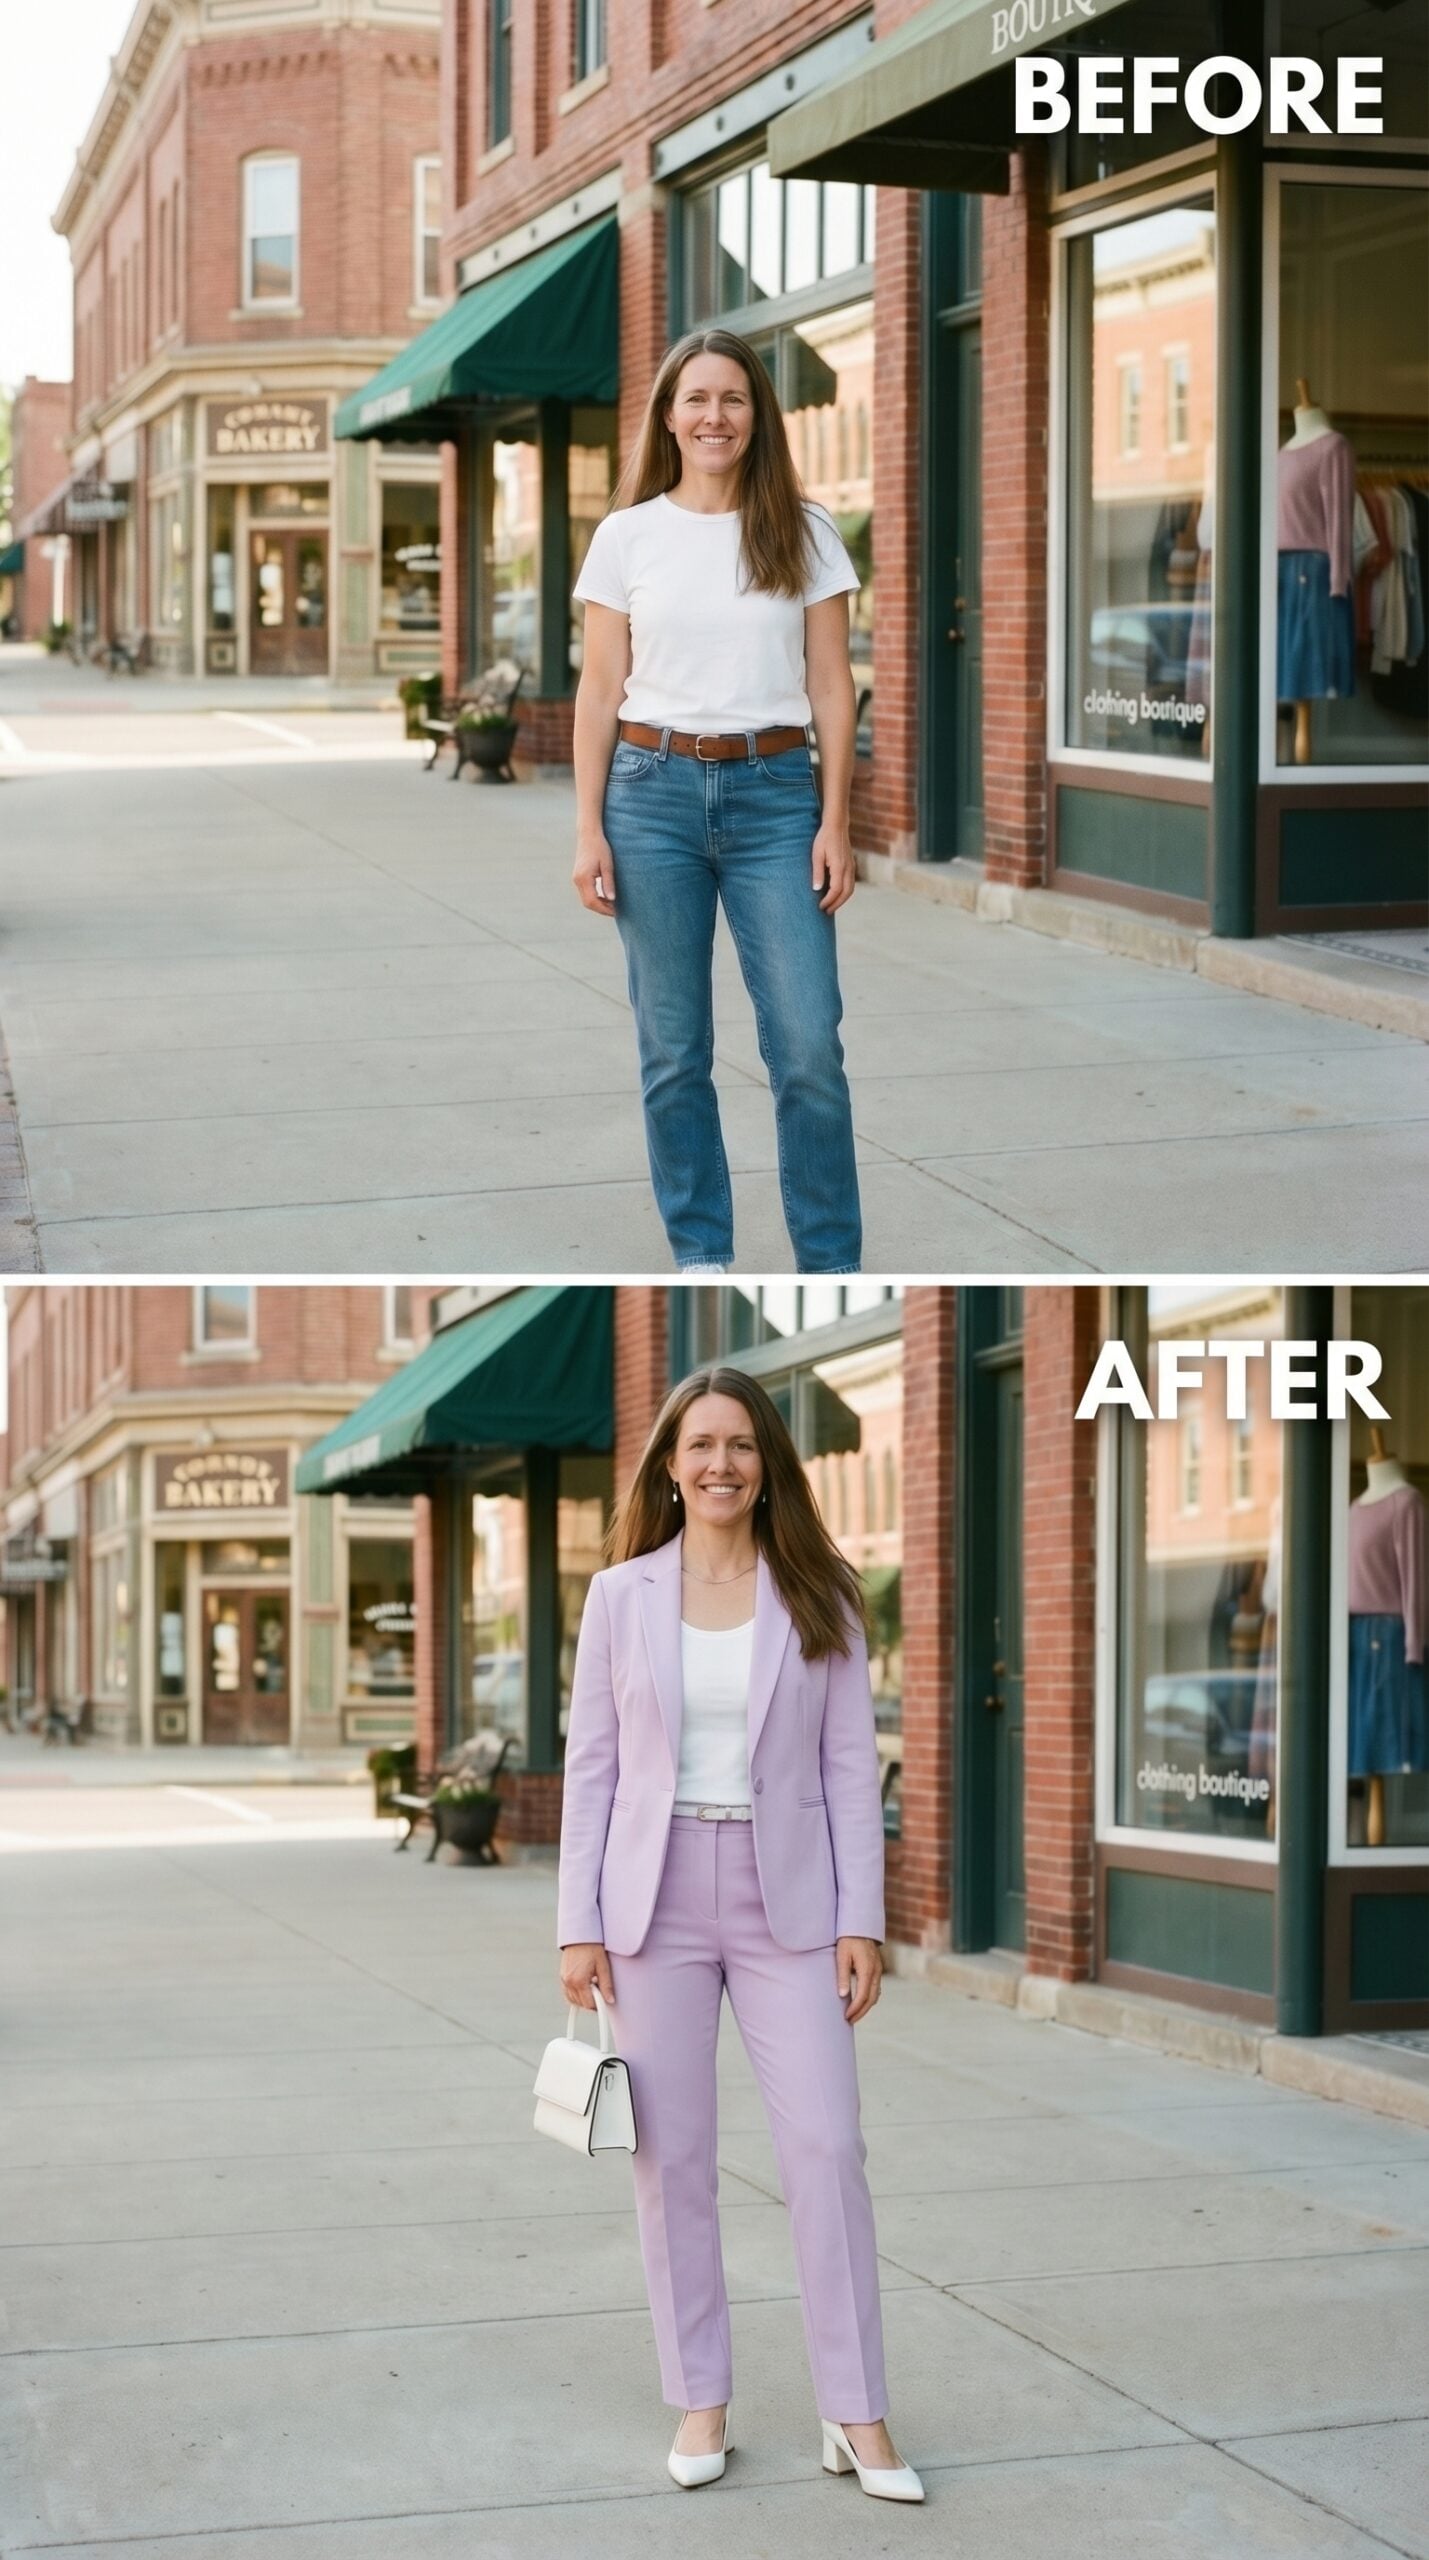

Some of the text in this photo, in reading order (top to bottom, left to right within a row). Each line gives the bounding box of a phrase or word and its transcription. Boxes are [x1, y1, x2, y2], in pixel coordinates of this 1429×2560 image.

[990, 0, 1097, 55] BOU
[216, 425, 321, 453] BAKERY
[165, 1477, 280, 1507] BAKERY
[1136, 1760, 1270, 1807] clothing boutique
